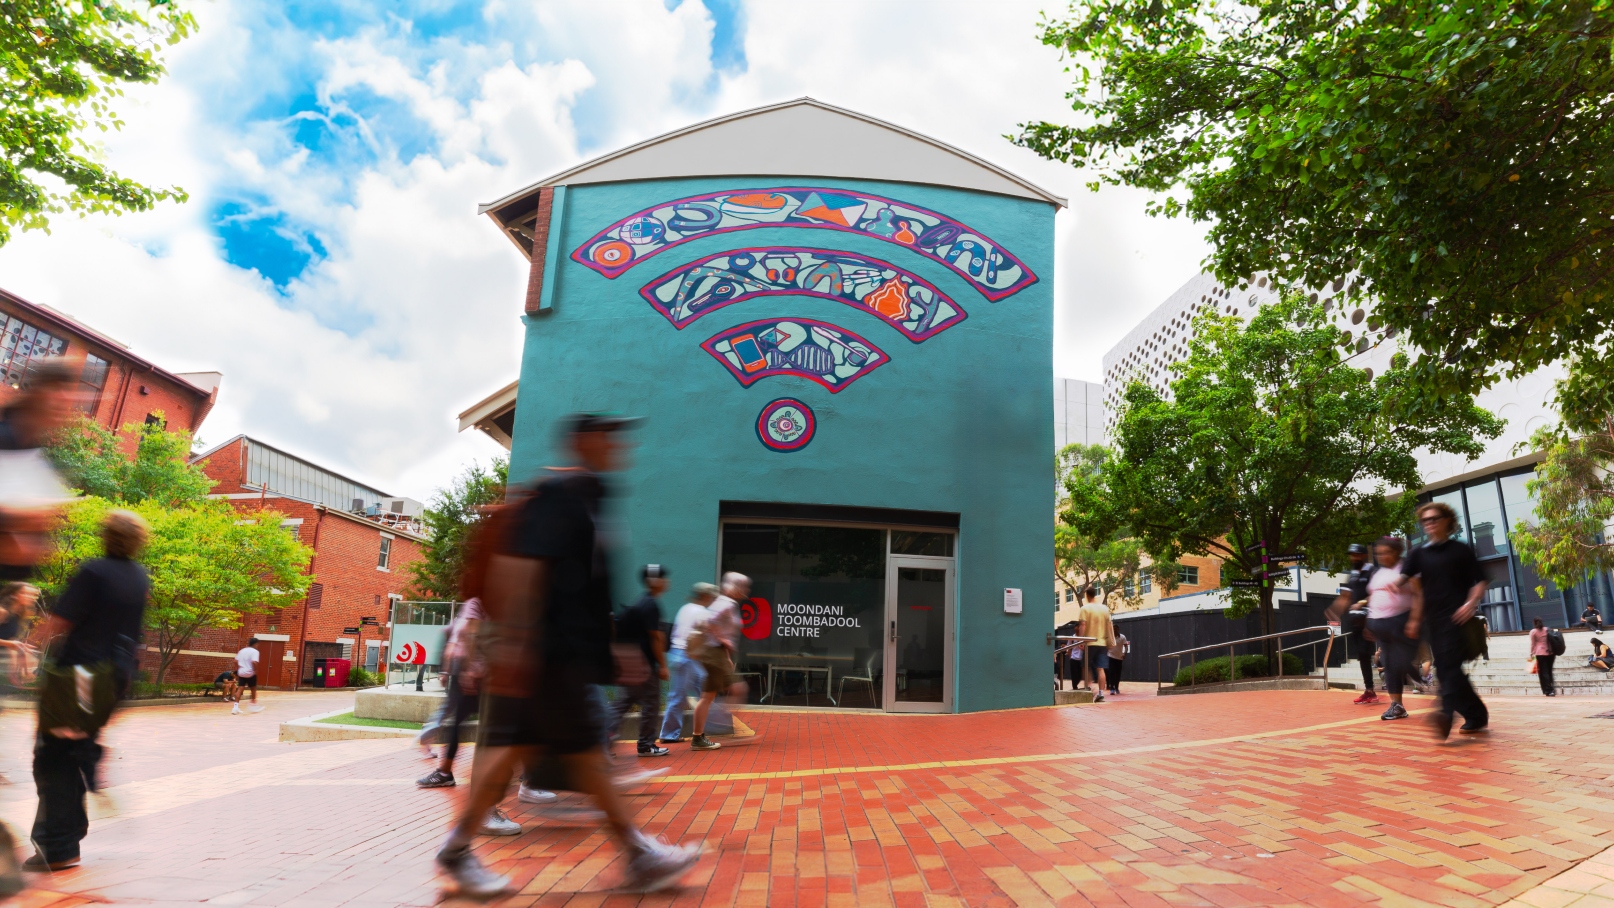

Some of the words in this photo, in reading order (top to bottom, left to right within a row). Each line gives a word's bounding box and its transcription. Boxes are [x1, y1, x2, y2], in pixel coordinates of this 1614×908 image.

[777, 604, 843, 616] MOONDANI
[777, 615, 861, 628] TOOMBADOOL
[776, 626, 820, 638] CENTRE
